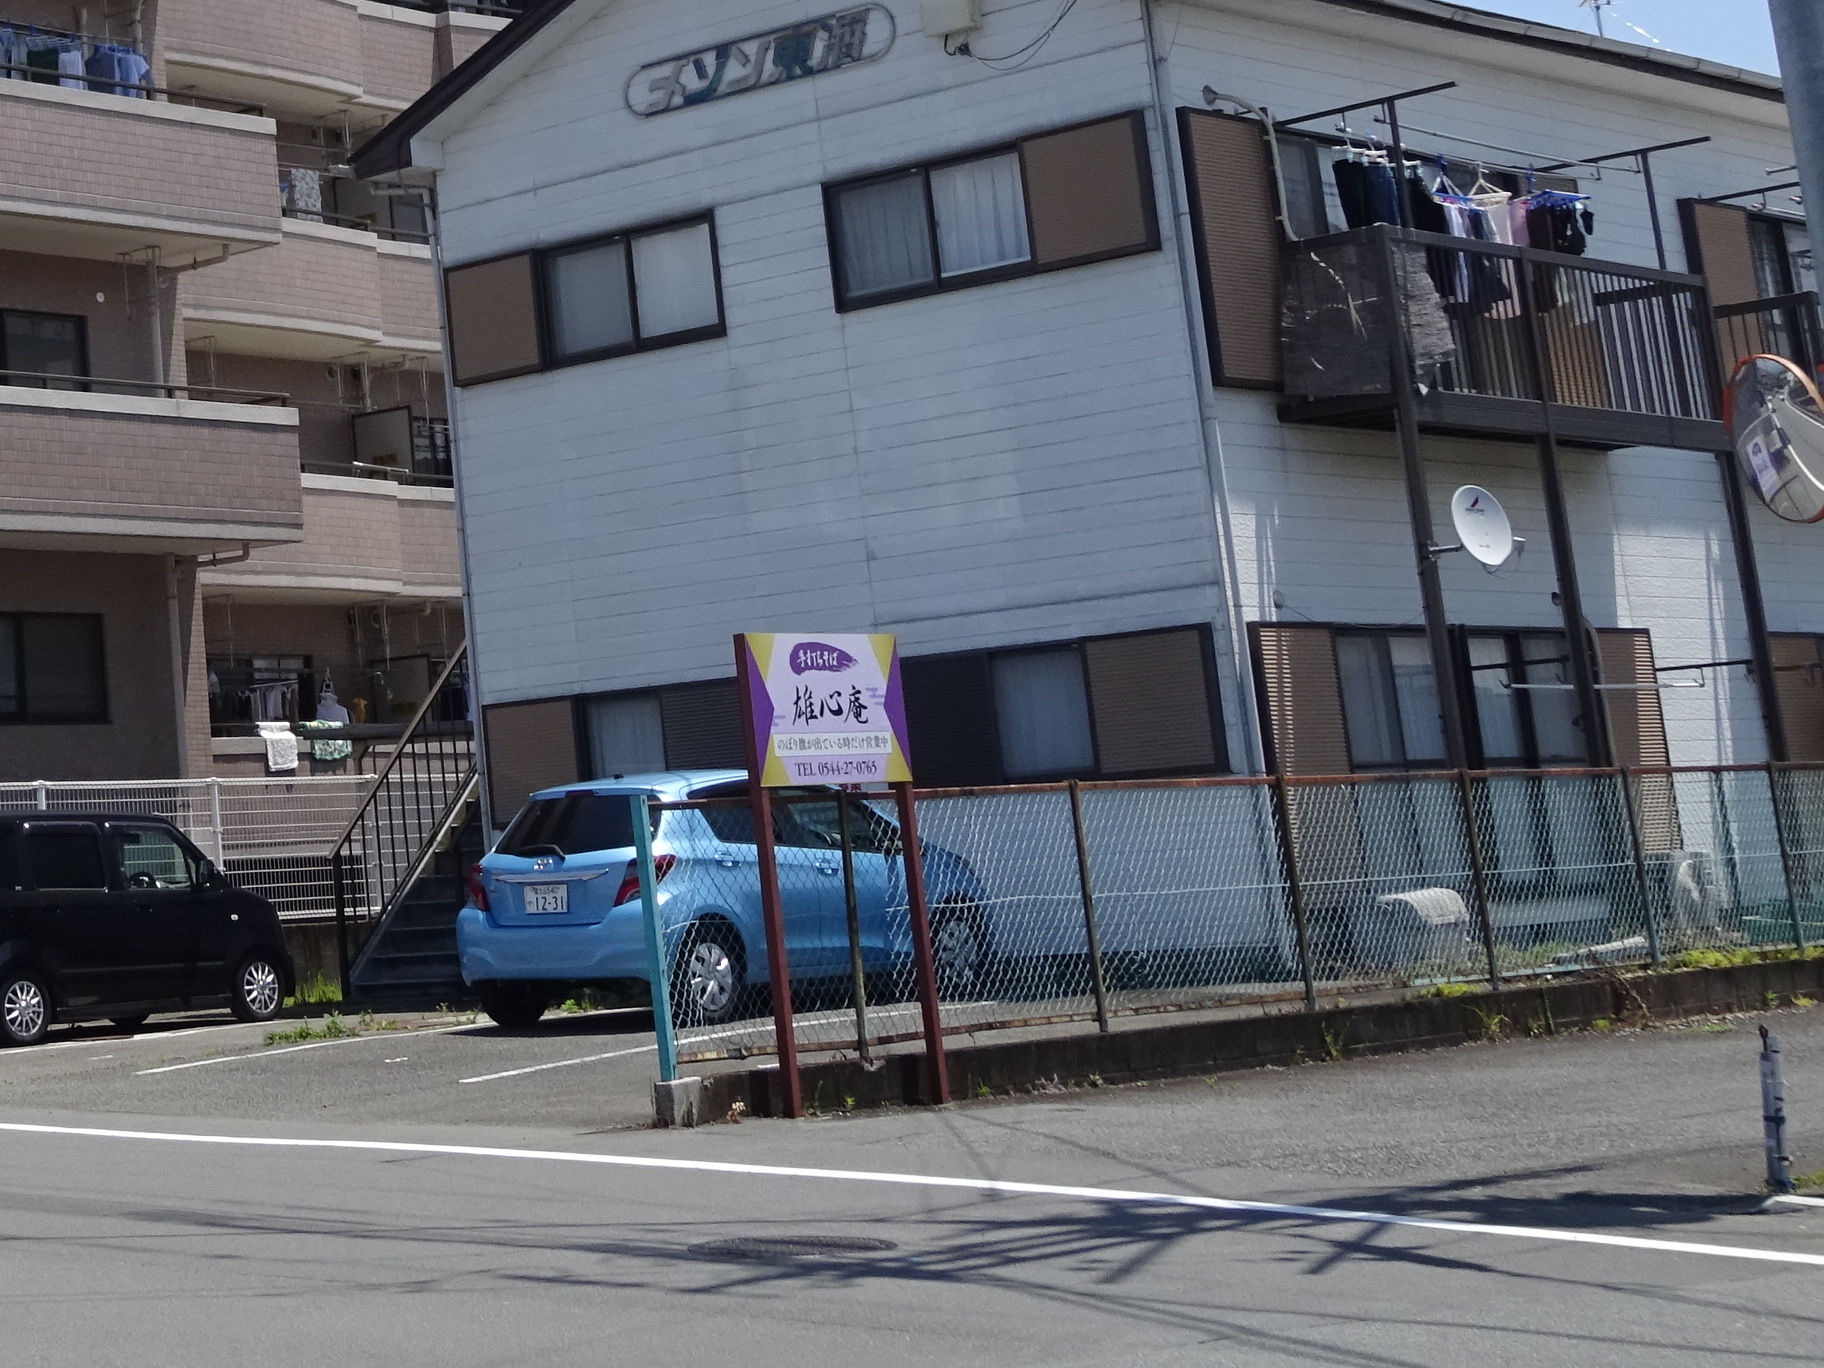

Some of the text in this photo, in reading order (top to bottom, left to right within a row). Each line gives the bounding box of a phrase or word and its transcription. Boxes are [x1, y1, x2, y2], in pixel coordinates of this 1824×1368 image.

[793, 684, 869, 726] 雄心庵
[795, 762, 816, 776] TEL
